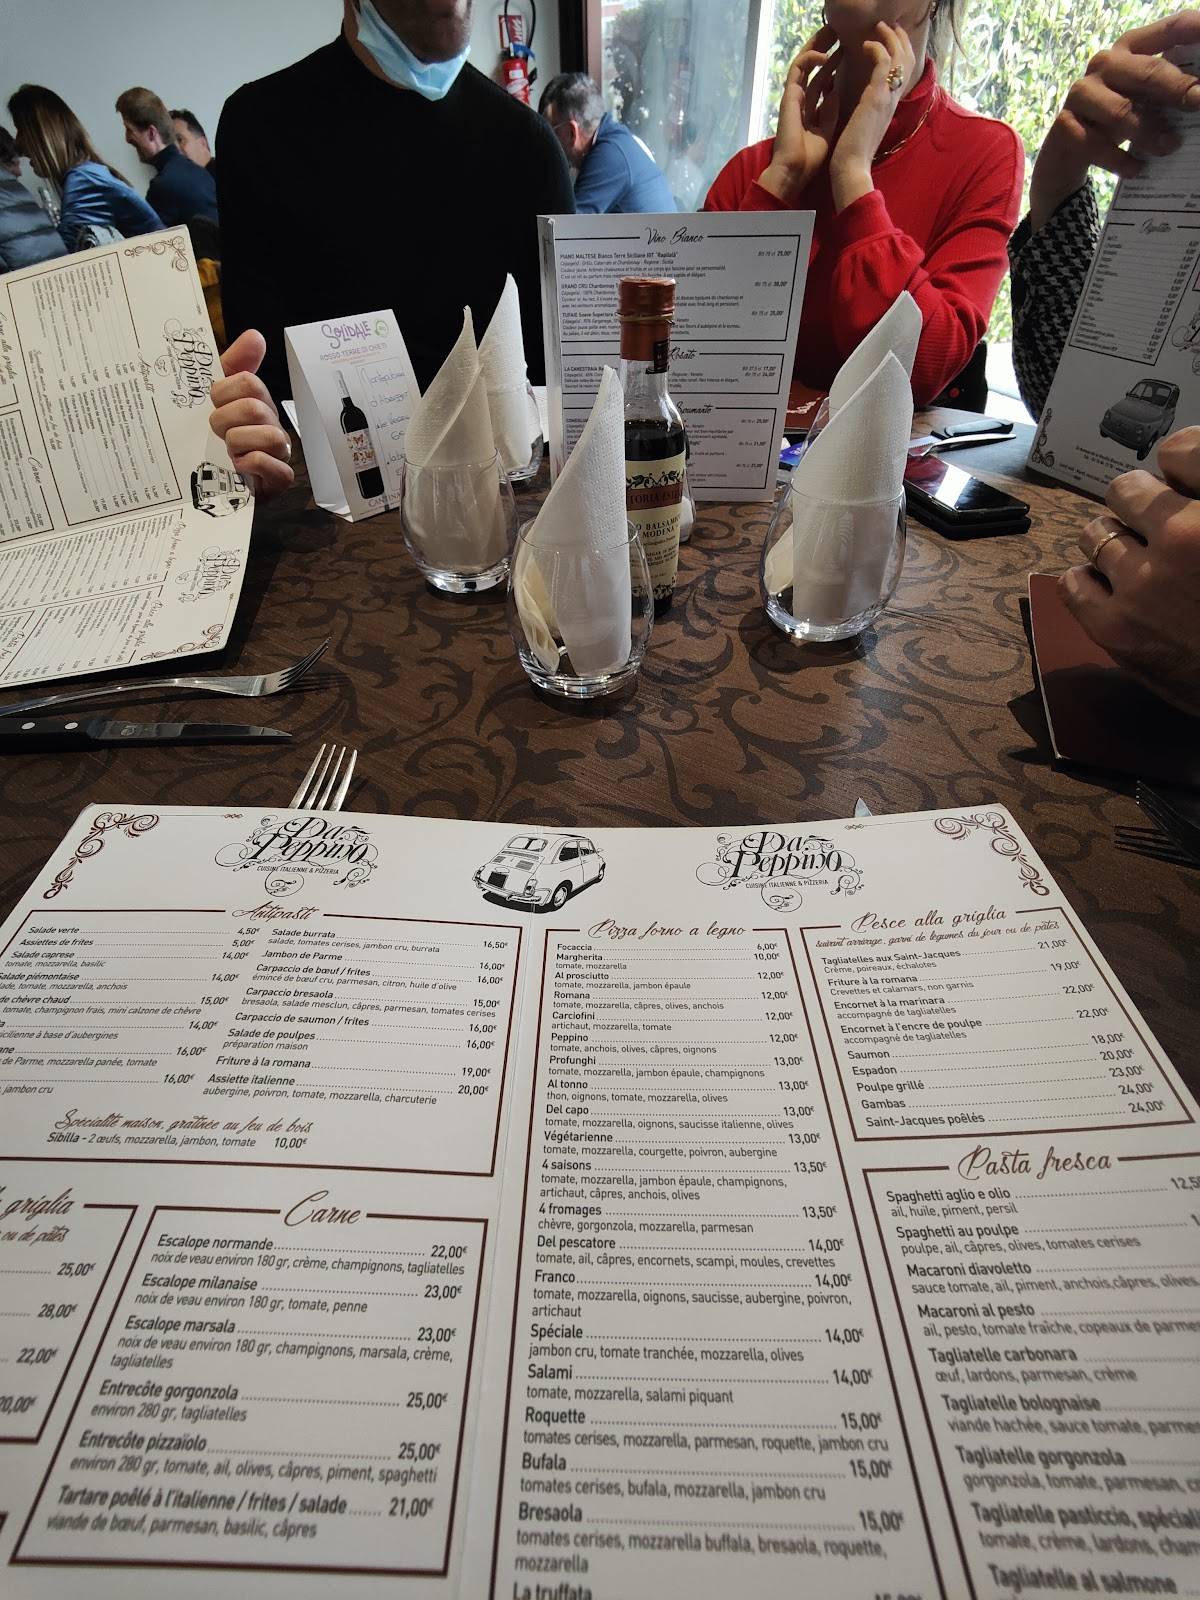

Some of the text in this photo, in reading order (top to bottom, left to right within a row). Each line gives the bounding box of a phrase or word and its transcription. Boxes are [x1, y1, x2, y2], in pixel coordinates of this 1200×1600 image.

[645, 225, 704, 246] Vino Bianco
[321, 320, 372, 350] SOLIDALE
[643, 525, 676, 538] MODENA
[250, 817, 368, 863] Da Peppino
[723, 832, 842, 877] Da Peppino
[232, 901, 319, 921] Antipasti
[851, 906, 1007, 932] Pesce alla griglia
[236, 927, 260, 935] 4,50€
[271, 928, 507, 948] Salade burrata 16,50€
[588, 919, 746, 939] Pizza forno a legno
[231, 939, 255, 947] 5,00€
[756, 942, 777, 951] 6,00€
[820, 938, 1068, 964] Tagliatelles aux Saint-Jacques 21,00€
[261, 949, 297, 958] Jambon
[312, 951, 342, 960] Parme
[479, 961, 504, 970] 16,00€
[556, 952, 778, 962] Margherita 10,00€
[256, 963, 502, 984] Carpaccio de bœuf / frites 16,00€
[566, 972, 609, 980] prosciutto
[757, 971, 783, 980] 12,00€
[245, 987, 499, 1008] Carpaccio bresaola 15,00€
[227, 1028, 494, 1049] Salade de poulpes 16,00€
[551, 1032, 798, 1043] Peppino 12,00€
[847, 1032, 1124, 1059] Saumon 18,00€
[851, 1048, 1134, 1077] Espadon 20,00€
[207, 1073, 488, 1095] Assiette italienne 20,00€
[861, 1082, 1153, 1109] Gambas 24,00€
[865, 1100, 1164, 1127] Saint-Jacques poêlés 24,00€
[544, 1130, 820, 1144] Végétarienne 13,00€
[541, 1158, 827, 1174] 4 saisons 13,50€
[958, 1145, 1111, 1181] Pasta fresca
[886, 1186, 1010, 1204] Spaghetti aglio e olio
[284, 1190, 361, 1226] Carne
[890, 1201, 1018, 1218] ail, huile, piment, persil
[157, 1233, 467, 1260] Escalope normande 22,00€
[537, 1234, 843, 1253] Del pescatore 14,00€
[534, 1269, 851, 1288] Franco 14,00€
[906, 1261, 1031, 1276] Macaroni diavoletto
[530, 1323, 864, 1344] Spéciale 14,00€
[927, 1346, 1077, 1365] Tagliatelle carbonara
[98, 1378, 447, 1410] Entrecôte gorgonzola 25,00€
[525, 1406, 881, 1432] Roquette 15,00€
[78, 1429, 440, 1462] Entrecôte pizzaïolo 25,00€
[518, 1501, 903, 1533] Bresaola 15,00€
